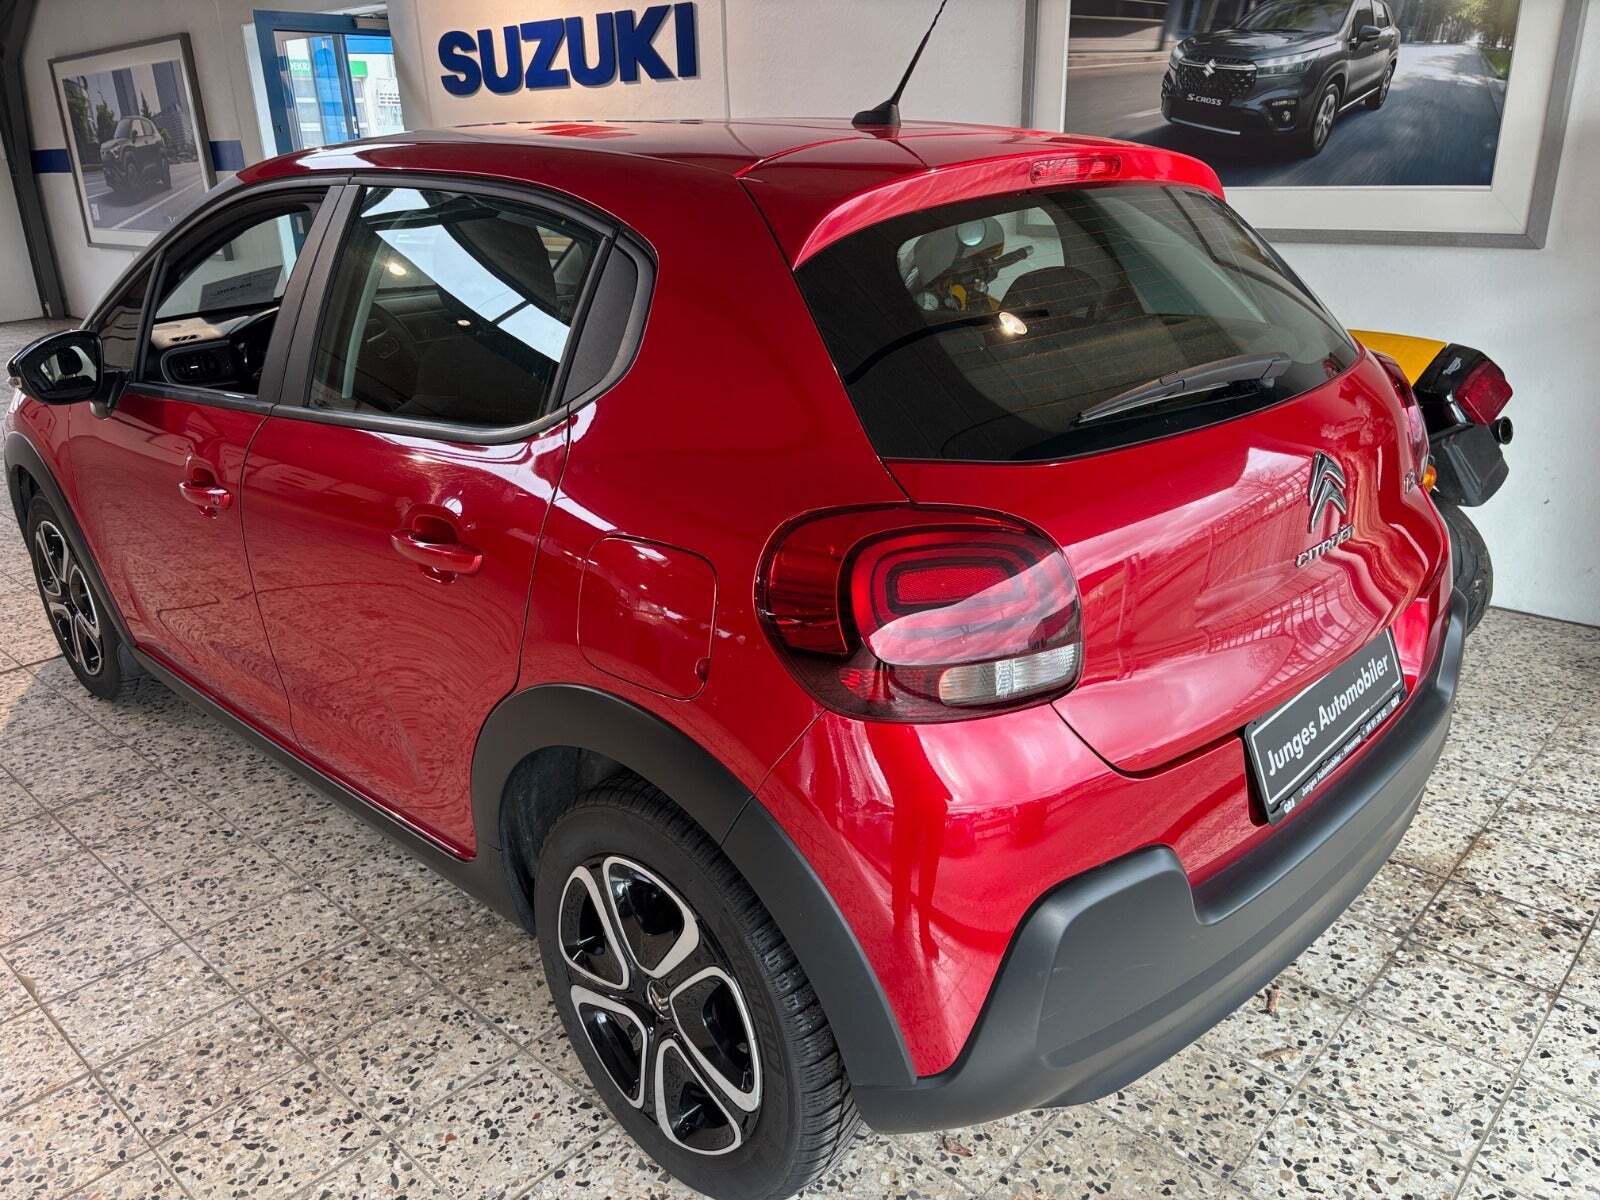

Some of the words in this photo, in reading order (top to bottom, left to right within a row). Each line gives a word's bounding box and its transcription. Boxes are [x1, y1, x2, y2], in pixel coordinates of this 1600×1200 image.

[438, 2, 698, 96] SUZUKI
[1268, 720, 1317, 777] Junges
[1318, 654, 1389, 731] Automobiler
